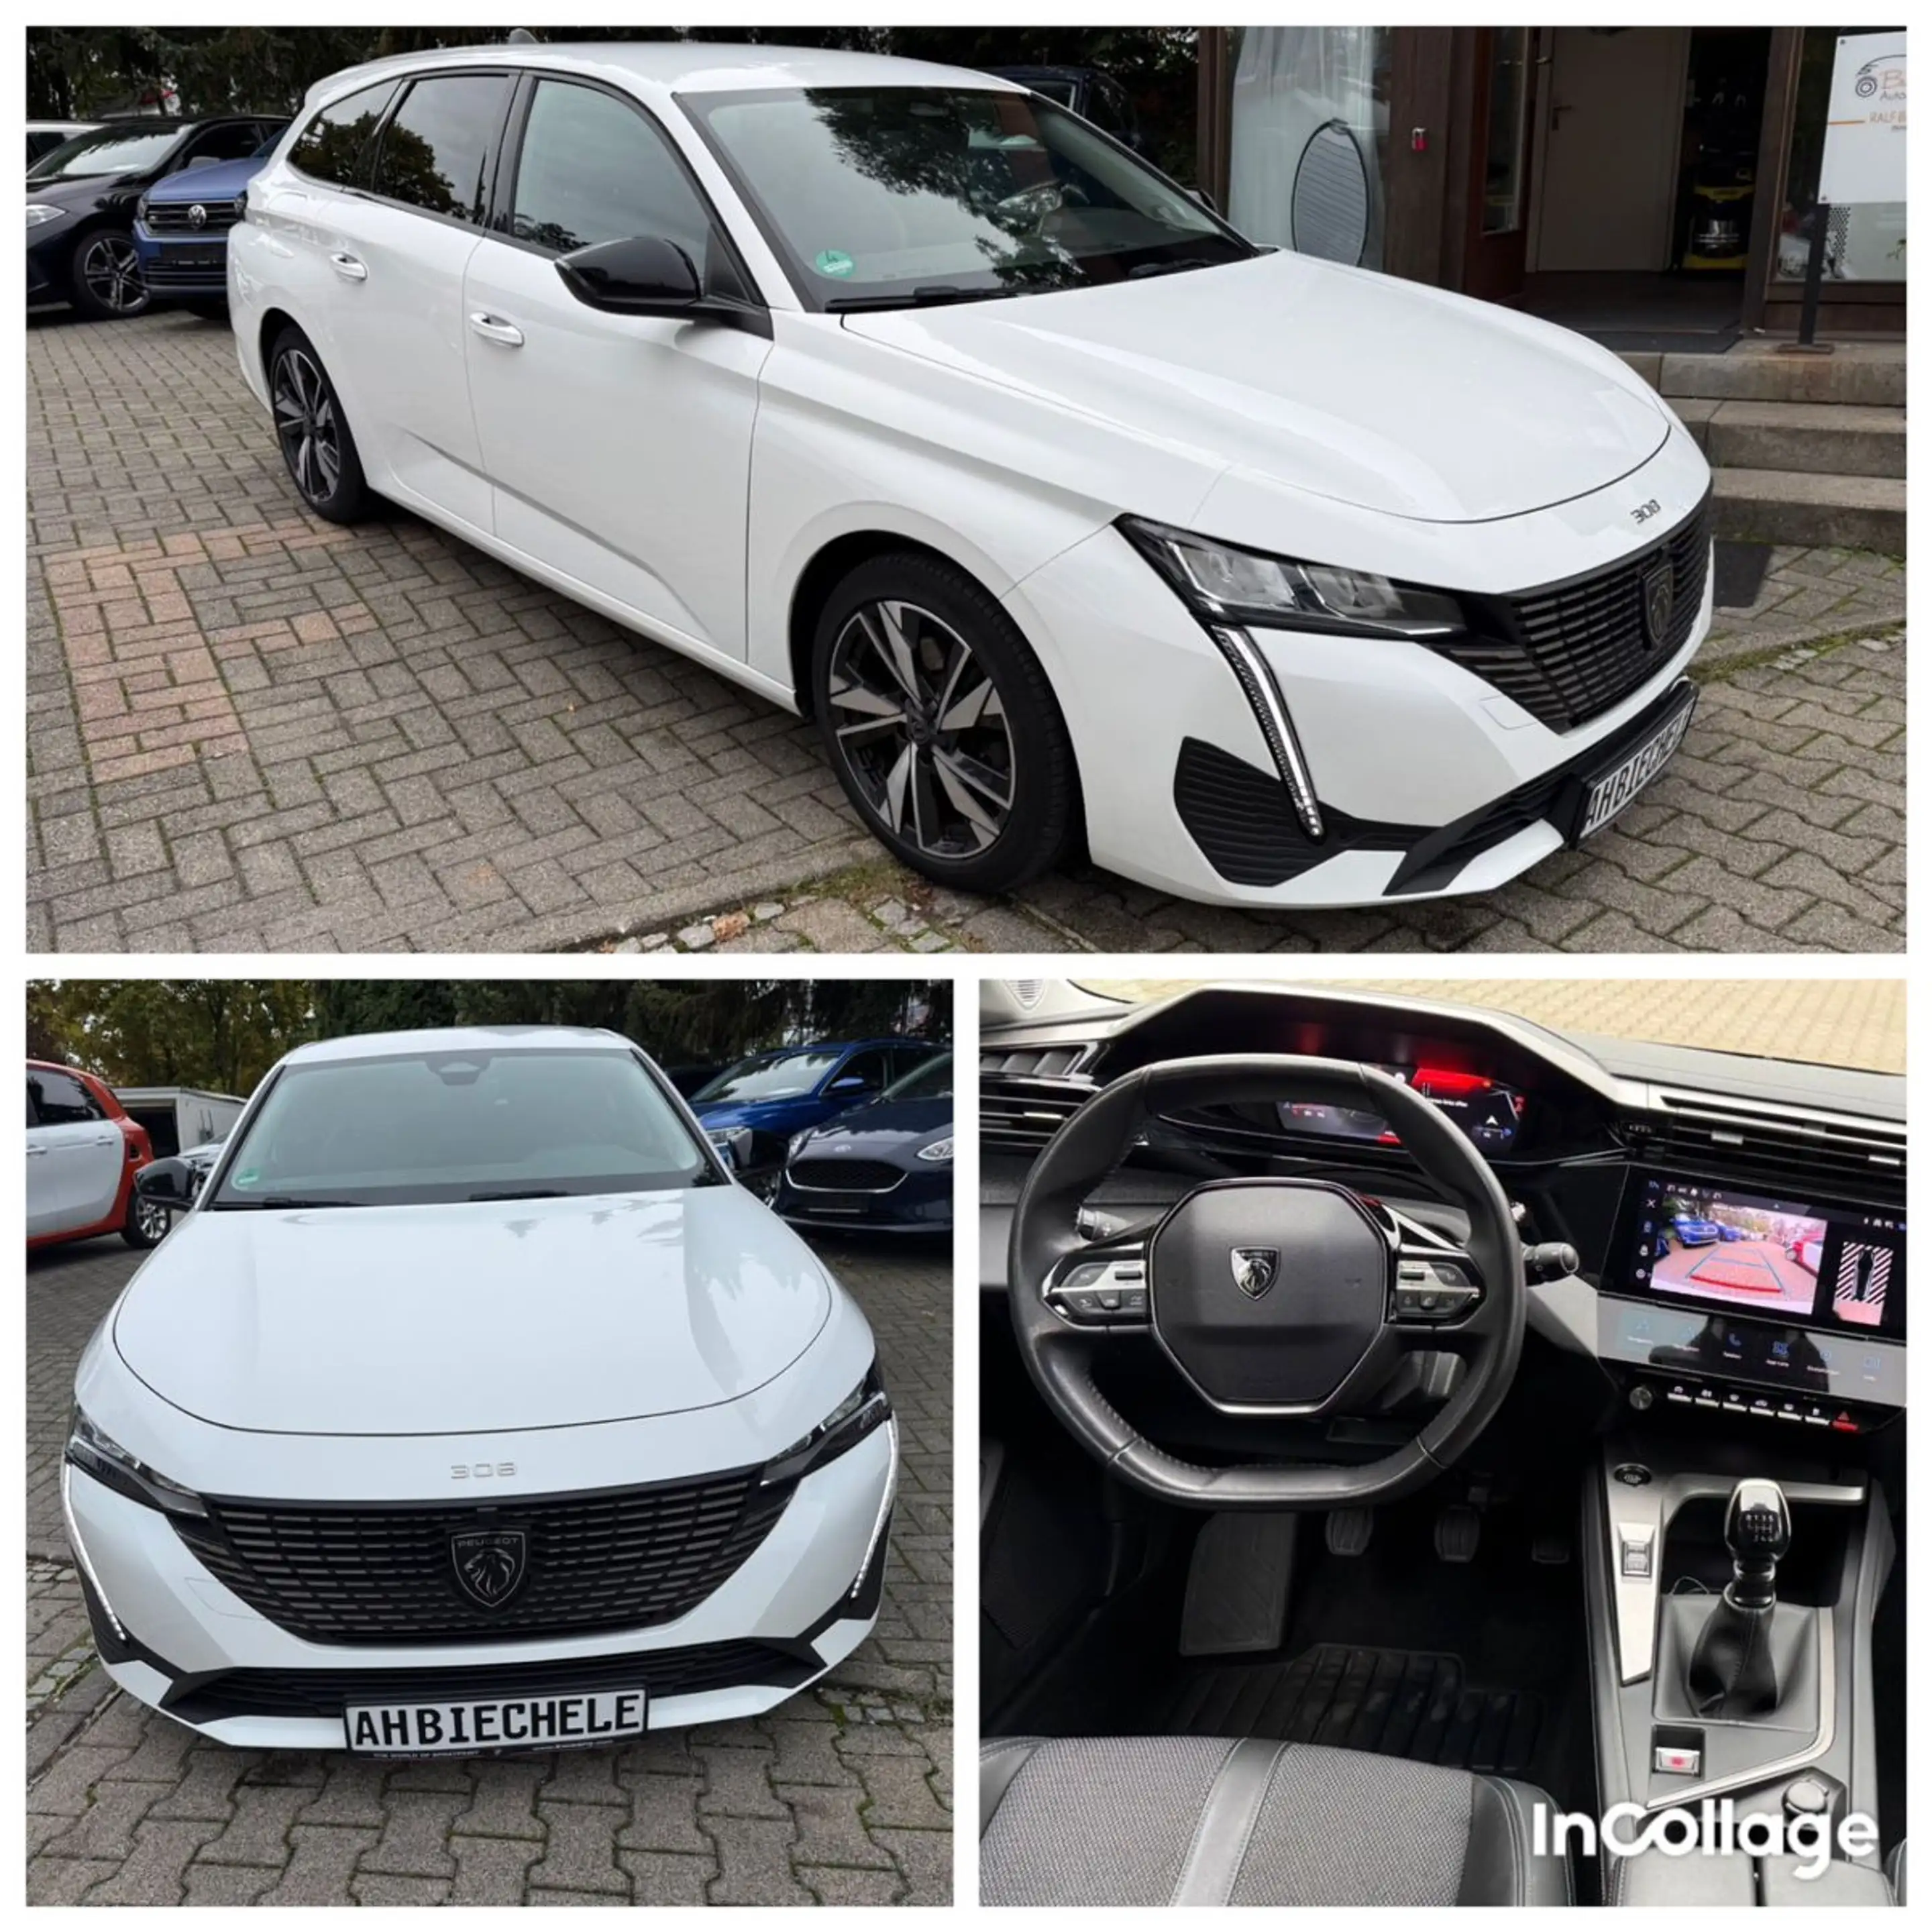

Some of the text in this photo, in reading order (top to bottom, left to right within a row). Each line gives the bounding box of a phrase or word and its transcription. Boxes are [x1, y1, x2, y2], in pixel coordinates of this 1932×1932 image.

[1630, 499, 1660, 524] 308
[451, 1462, 516, 1479] 308
[356, 1695, 639, 1746] AHBIECHELE
